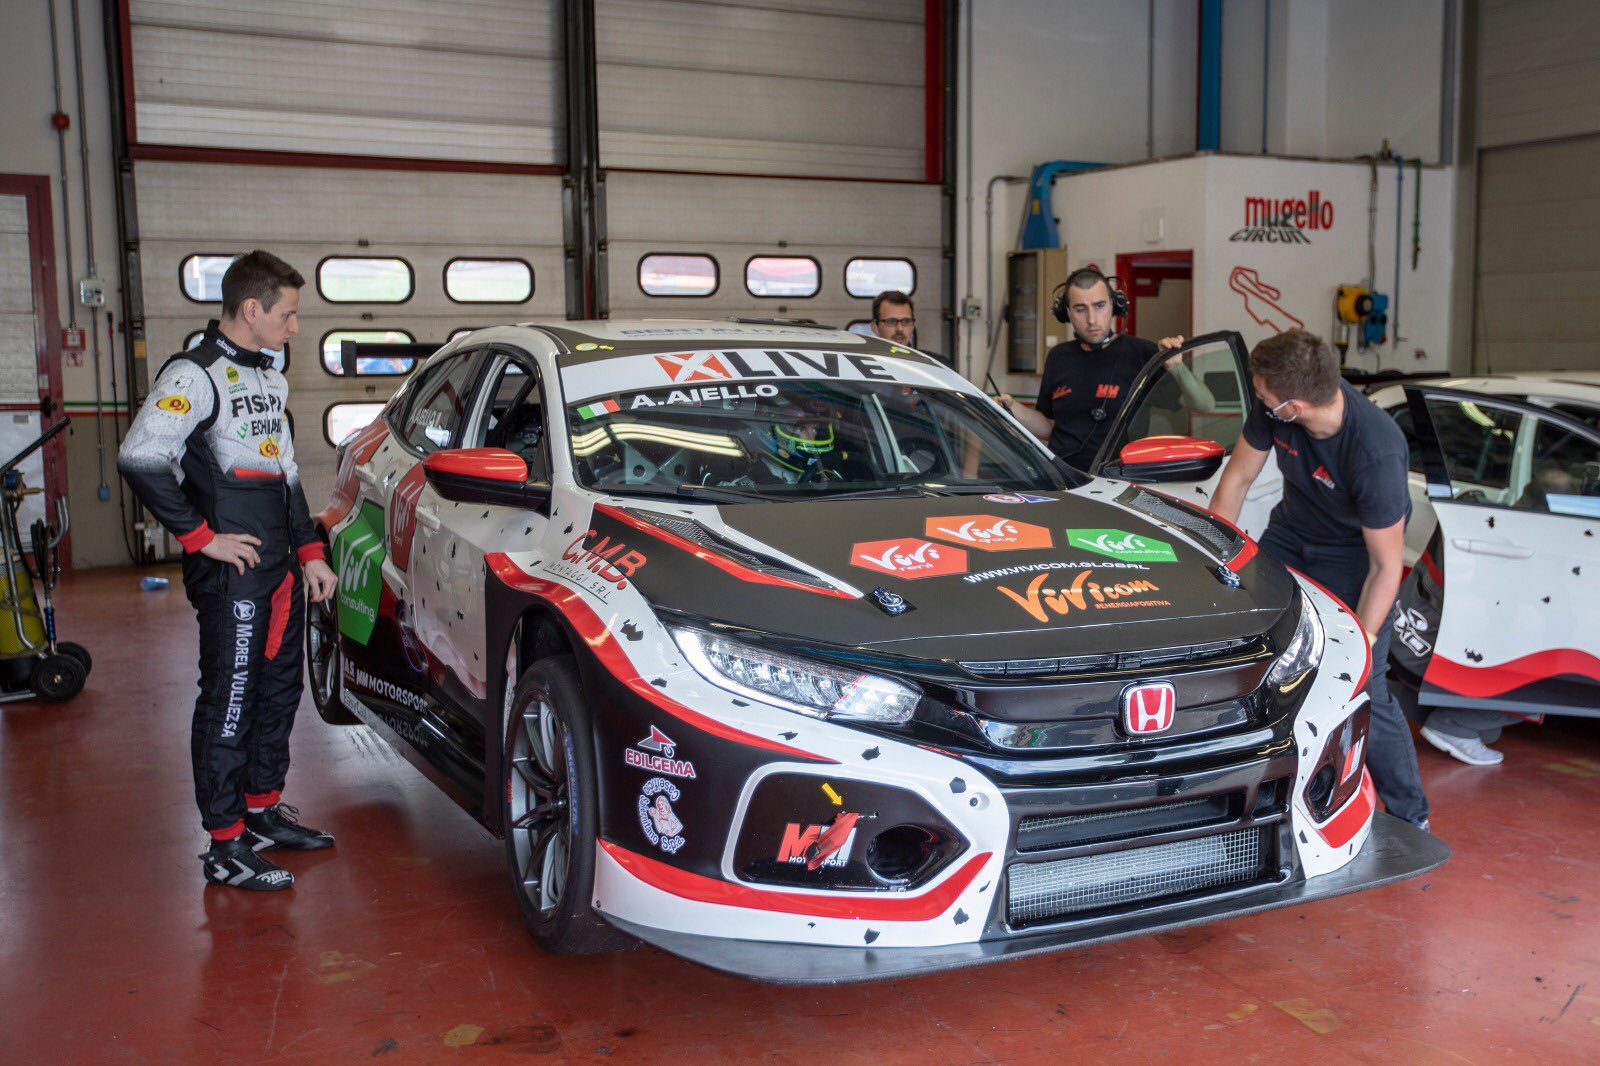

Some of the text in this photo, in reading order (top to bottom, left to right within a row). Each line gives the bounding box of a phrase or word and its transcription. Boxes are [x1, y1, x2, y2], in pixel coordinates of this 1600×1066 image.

[1245, 189, 1334, 230] mugello
[1228, 225, 1312, 244] CIRCUIT
[631, 384, 779, 409] A.AIELLO
[963, 561, 1151, 584] WWW.VIVICOM.GLOBAL
[589, 582, 612, 599] SRL
[340, 592, 375, 622] consulting
[234, 623, 253, 669] MOREL
[369, 675, 428, 716] MOTORSPORT
[625, 747, 697, 778] EDILGEMA
